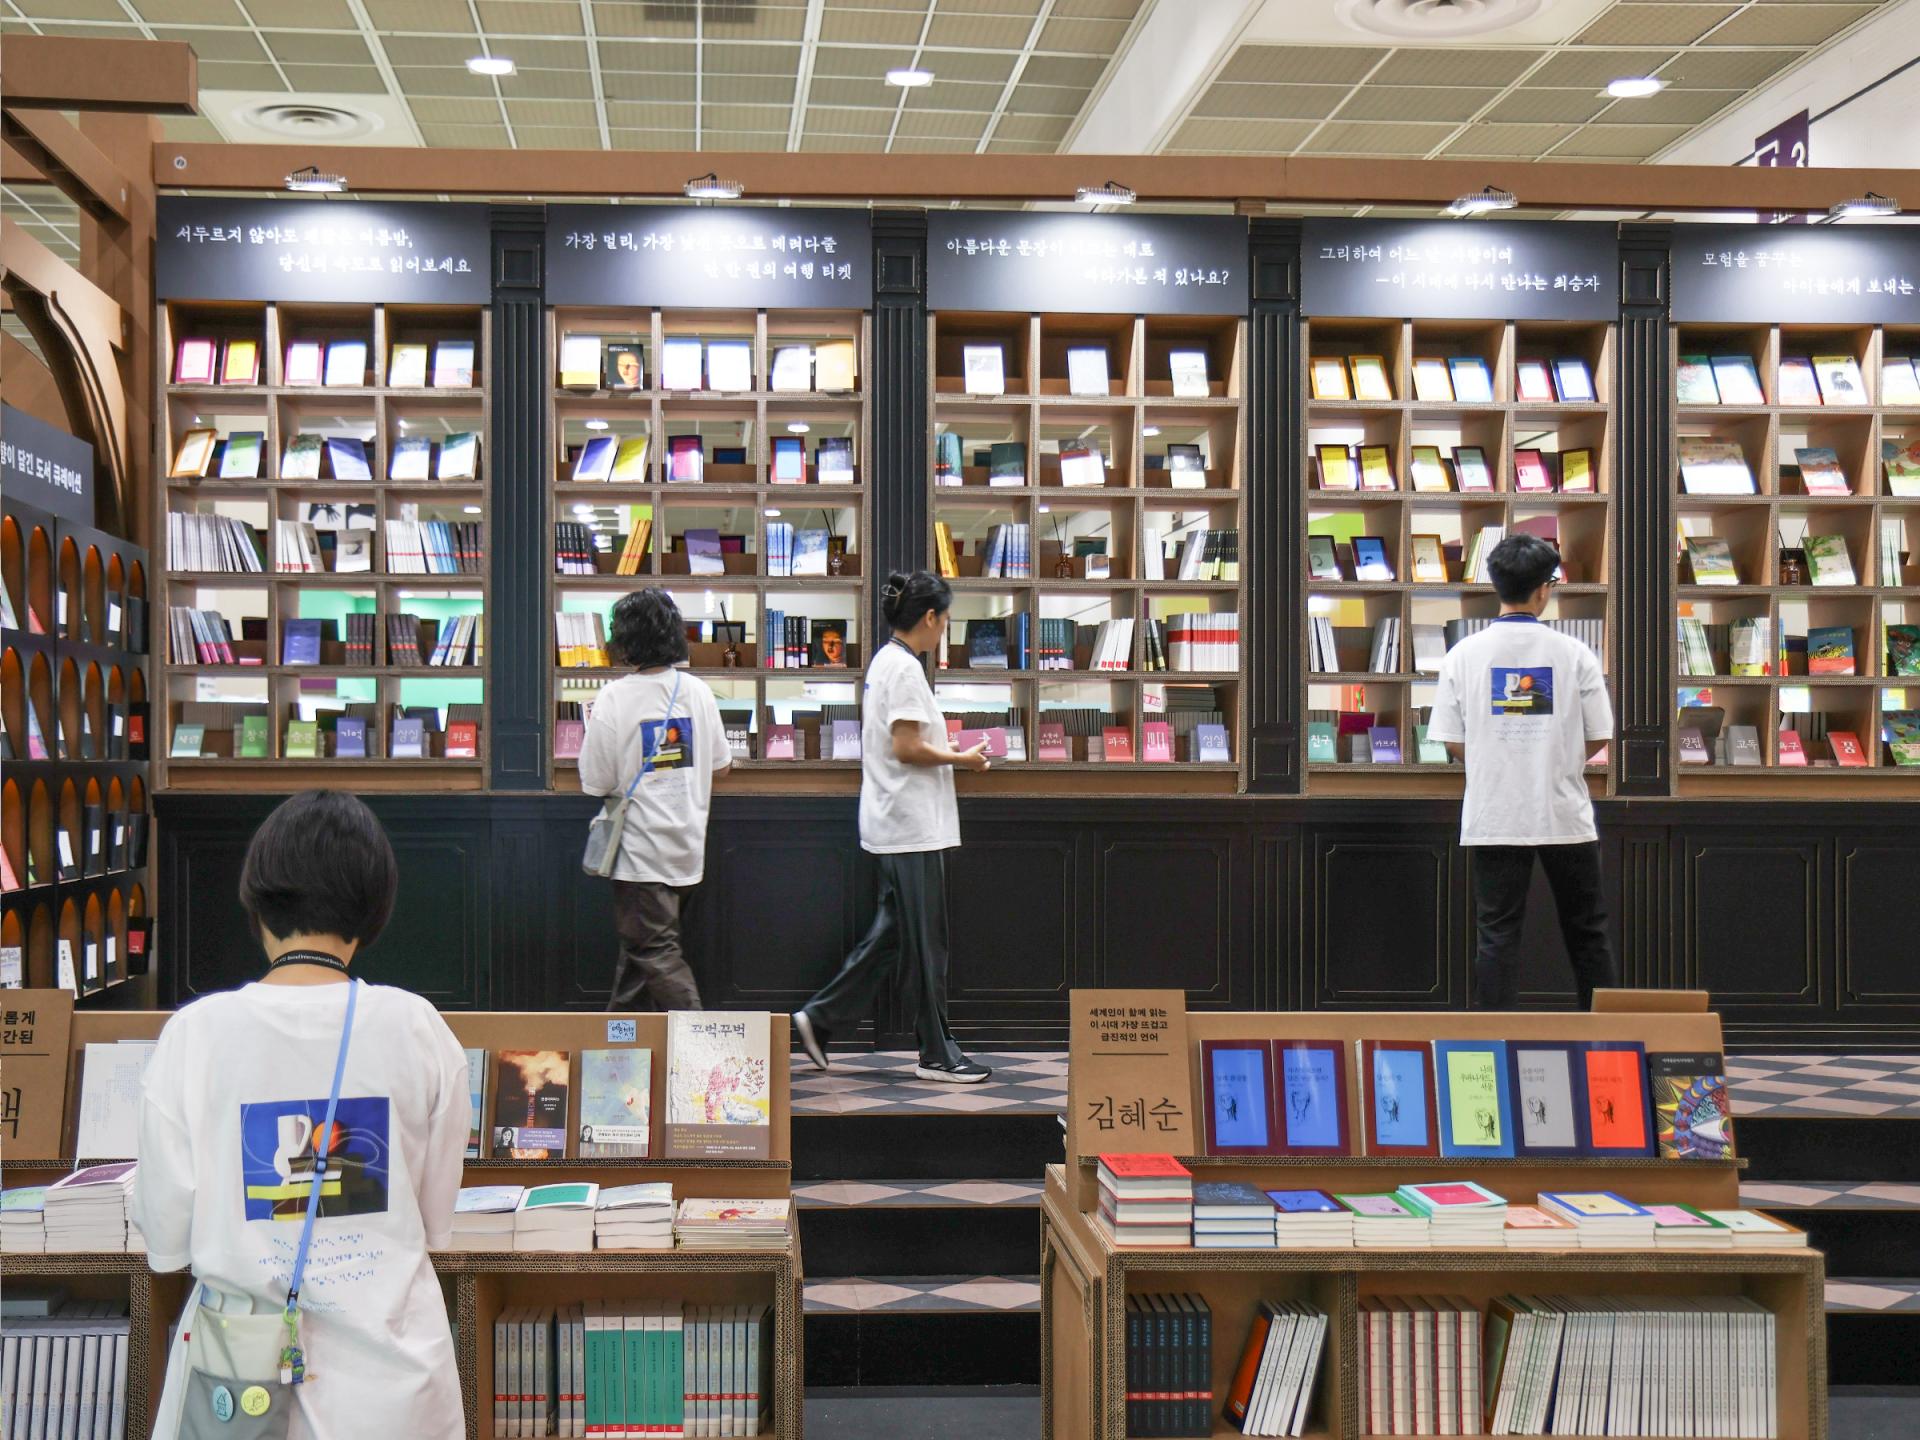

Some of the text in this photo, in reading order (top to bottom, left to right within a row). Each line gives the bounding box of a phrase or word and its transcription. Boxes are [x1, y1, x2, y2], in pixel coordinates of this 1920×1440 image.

[176, 225, 242, 243] 서두르지
[249, 226, 298, 244] 않아도
[360, 229, 413, 248] 여름밤,
[565, 232, 597, 250] 가장
[603, 233, 638, 251] 멀리,
[644, 233, 673, 252] 가장
[772, 237, 837, 254] 데려다줄
[947, 239, 1011, 256] 아름다운
[1016, 240, 1063, 258] 문장이
[1320, 246, 1381, 263] 그리하여
[1389, 246, 1419, 263] 어느
[279, 256, 326, 273] 당신의
[391, 257, 471, 274] 읽어보세요
[1702, 251, 1803, 268] 모험을 꿈꾸는
[725, 263, 741, 279] 한
[746, 262, 776, 280] 권의
[784, 262, 814, 280] 여행
[822, 265, 851, 280] 티켓
[1153, 269, 1167, 286] 적
[1174, 269, 1229, 286] 있나요?
[1412, 275, 1459, 290] 시대에
[1465, 276, 1493, 290] 다시
[1501, 276, 1548, 292] 만나는
[1554, 276, 1600, 292] 최승자
[1784, 278, 1914, 295] 아이들에게 보내는
[18, 449, 34, 475] 담긴
[35, 457, 52, 484] 도서
[53, 464, 82, 494] 큐레이션
[341, 729, 362, 741] 기억
[397, 730, 418, 742] 상실
[836, 733, 858, 745] 이성
[1310, 734, 1330, 748] 친구
[1375, 739, 1397, 747] 카프카
[1680, 736, 1701, 749] 결핍
[1736, 739, 1757, 751] 고독
[1, 1010, 35, 1026] 롭게
[1090, 1008, 1167, 1017] 세계인이 함께 읽는
[1101, 1021, 1118, 1029] 시대
[1121, 1021, 1138, 1029] 가장
[1141, 1021, 1168, 1029] 뜨겁고
[1, 1030, 33, 1044] 간된
[1101, 1033, 1158, 1042] 급진적인 언어
[1088, 1096, 1182, 1131] 김혜순
